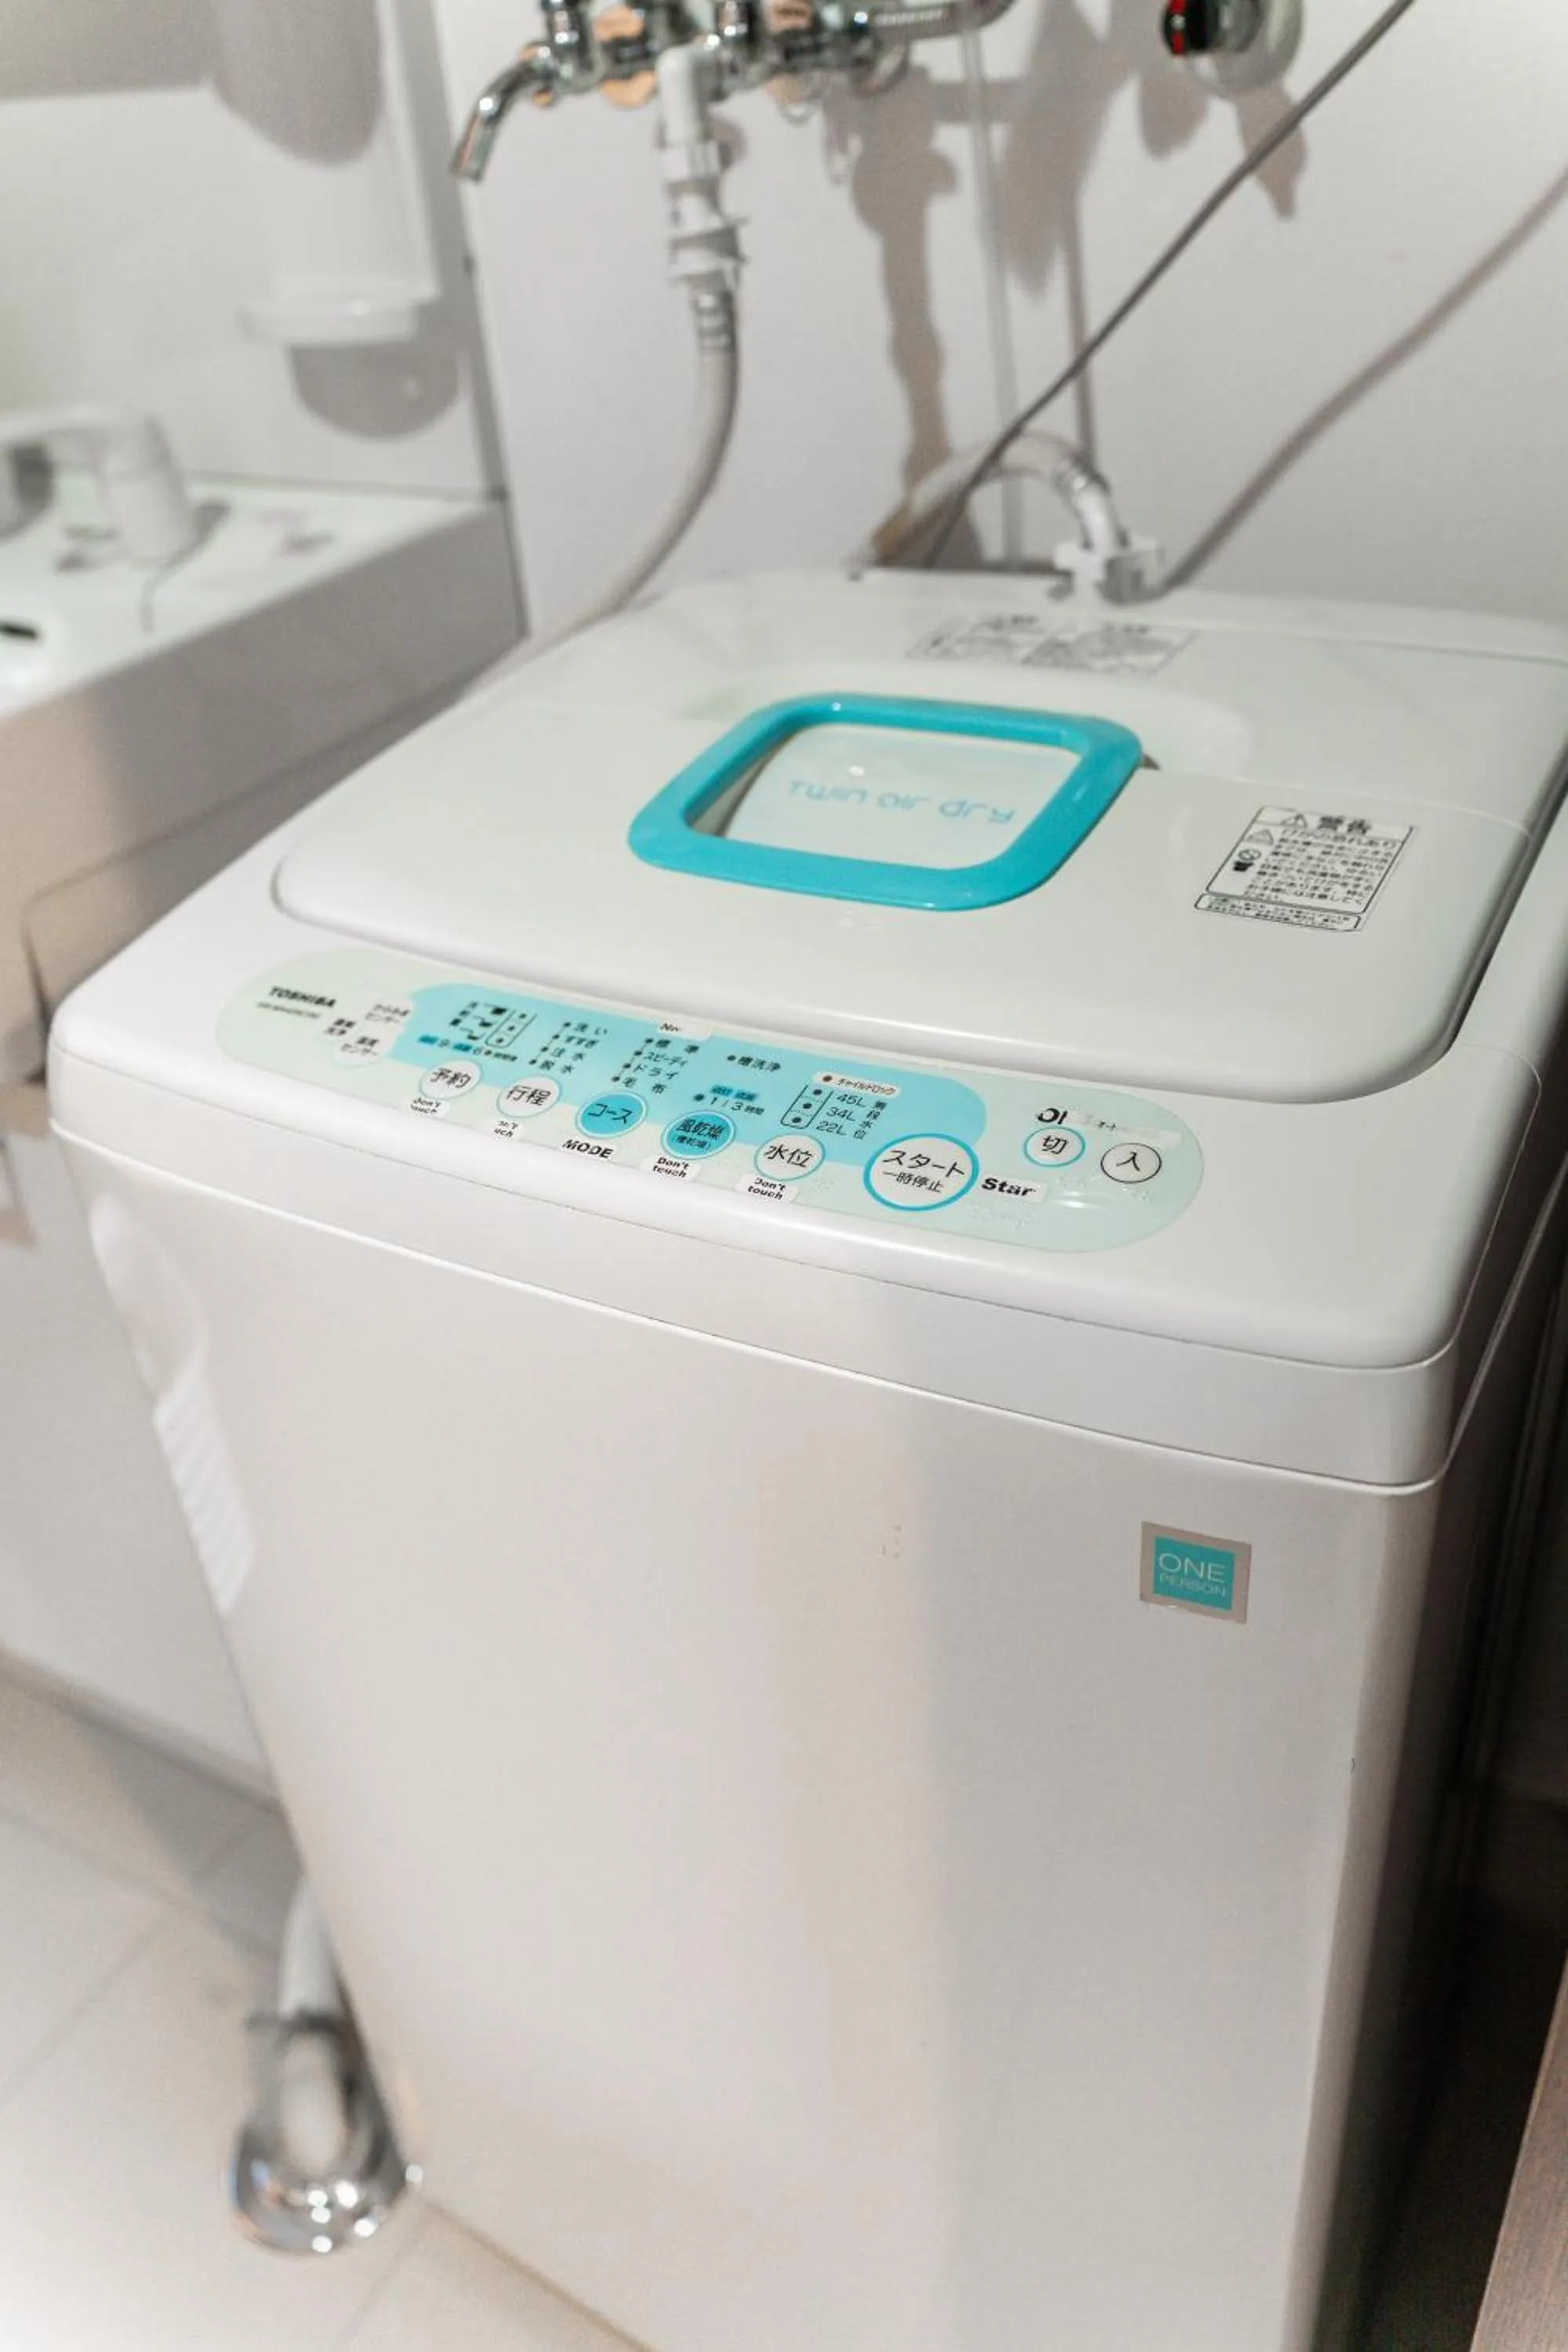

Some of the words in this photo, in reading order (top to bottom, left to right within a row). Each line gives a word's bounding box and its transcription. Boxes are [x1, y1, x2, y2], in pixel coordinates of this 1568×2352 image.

[269, 985, 337, 1007] TOSHIBA
[430, 1067, 472, 1089] 予約
[506, 1085, 552, 1106] 行程
[837, 1094, 866, 1108] 45L
[589, 1102, 633, 1124] コース
[826, 1107, 855, 1122] 34L
[815, 1120, 847, 1136] 22L
[562, 1139, 614, 1158] MODE
[1041, 1135, 1069, 1155] 切
[657, 1156, 689, 1170] Don't
[764, 1144, 814, 1168] 水位
[882, 1149, 965, 1178] スタート
[1116, 1151, 1142, 1172] 入
[652, 1165, 687, 1178] touch
[883, 1171, 945, 1193] 一時停止
[747, 1185, 783, 1200] touch
[1158, 1552, 1225, 1584] ONE
[1159, 1572, 1226, 1598] PERSON
